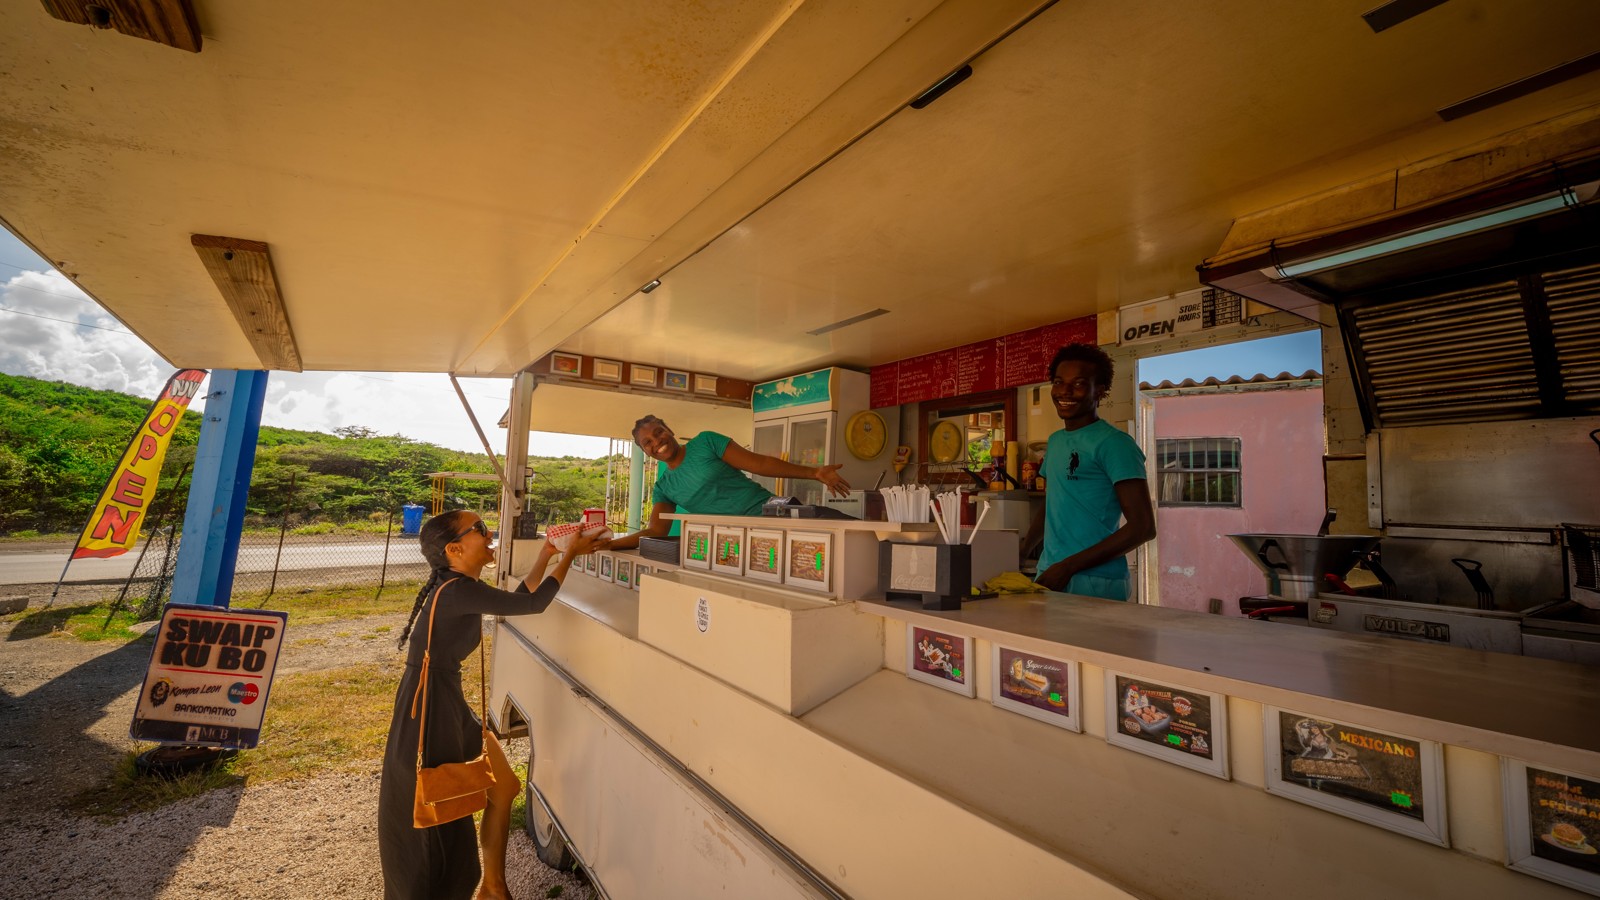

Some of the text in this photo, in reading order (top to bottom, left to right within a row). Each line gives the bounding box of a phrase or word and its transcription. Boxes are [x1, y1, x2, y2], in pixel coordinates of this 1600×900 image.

[1179, 302, 1201, 314] STORE
[1177, 312, 1201, 323] HOURS
[1124, 318, 1175, 341] OPEN
[90, 404, 180, 545] OPEN
[895, 574, 930, 589] Coca-Cola
[165, 617, 275, 648] SWAIP
[160, 641, 267, 672] KU BO
[1026, 659, 1042, 670] Super
[170, 684, 222, 697] Kompa Leon
[230, 688, 257, 698] Maestro
[174, 704, 237, 717] BANKOMATIKO
[201, 727, 229, 740] MCB
[1339, 731, 1415, 758] MEXICANO
